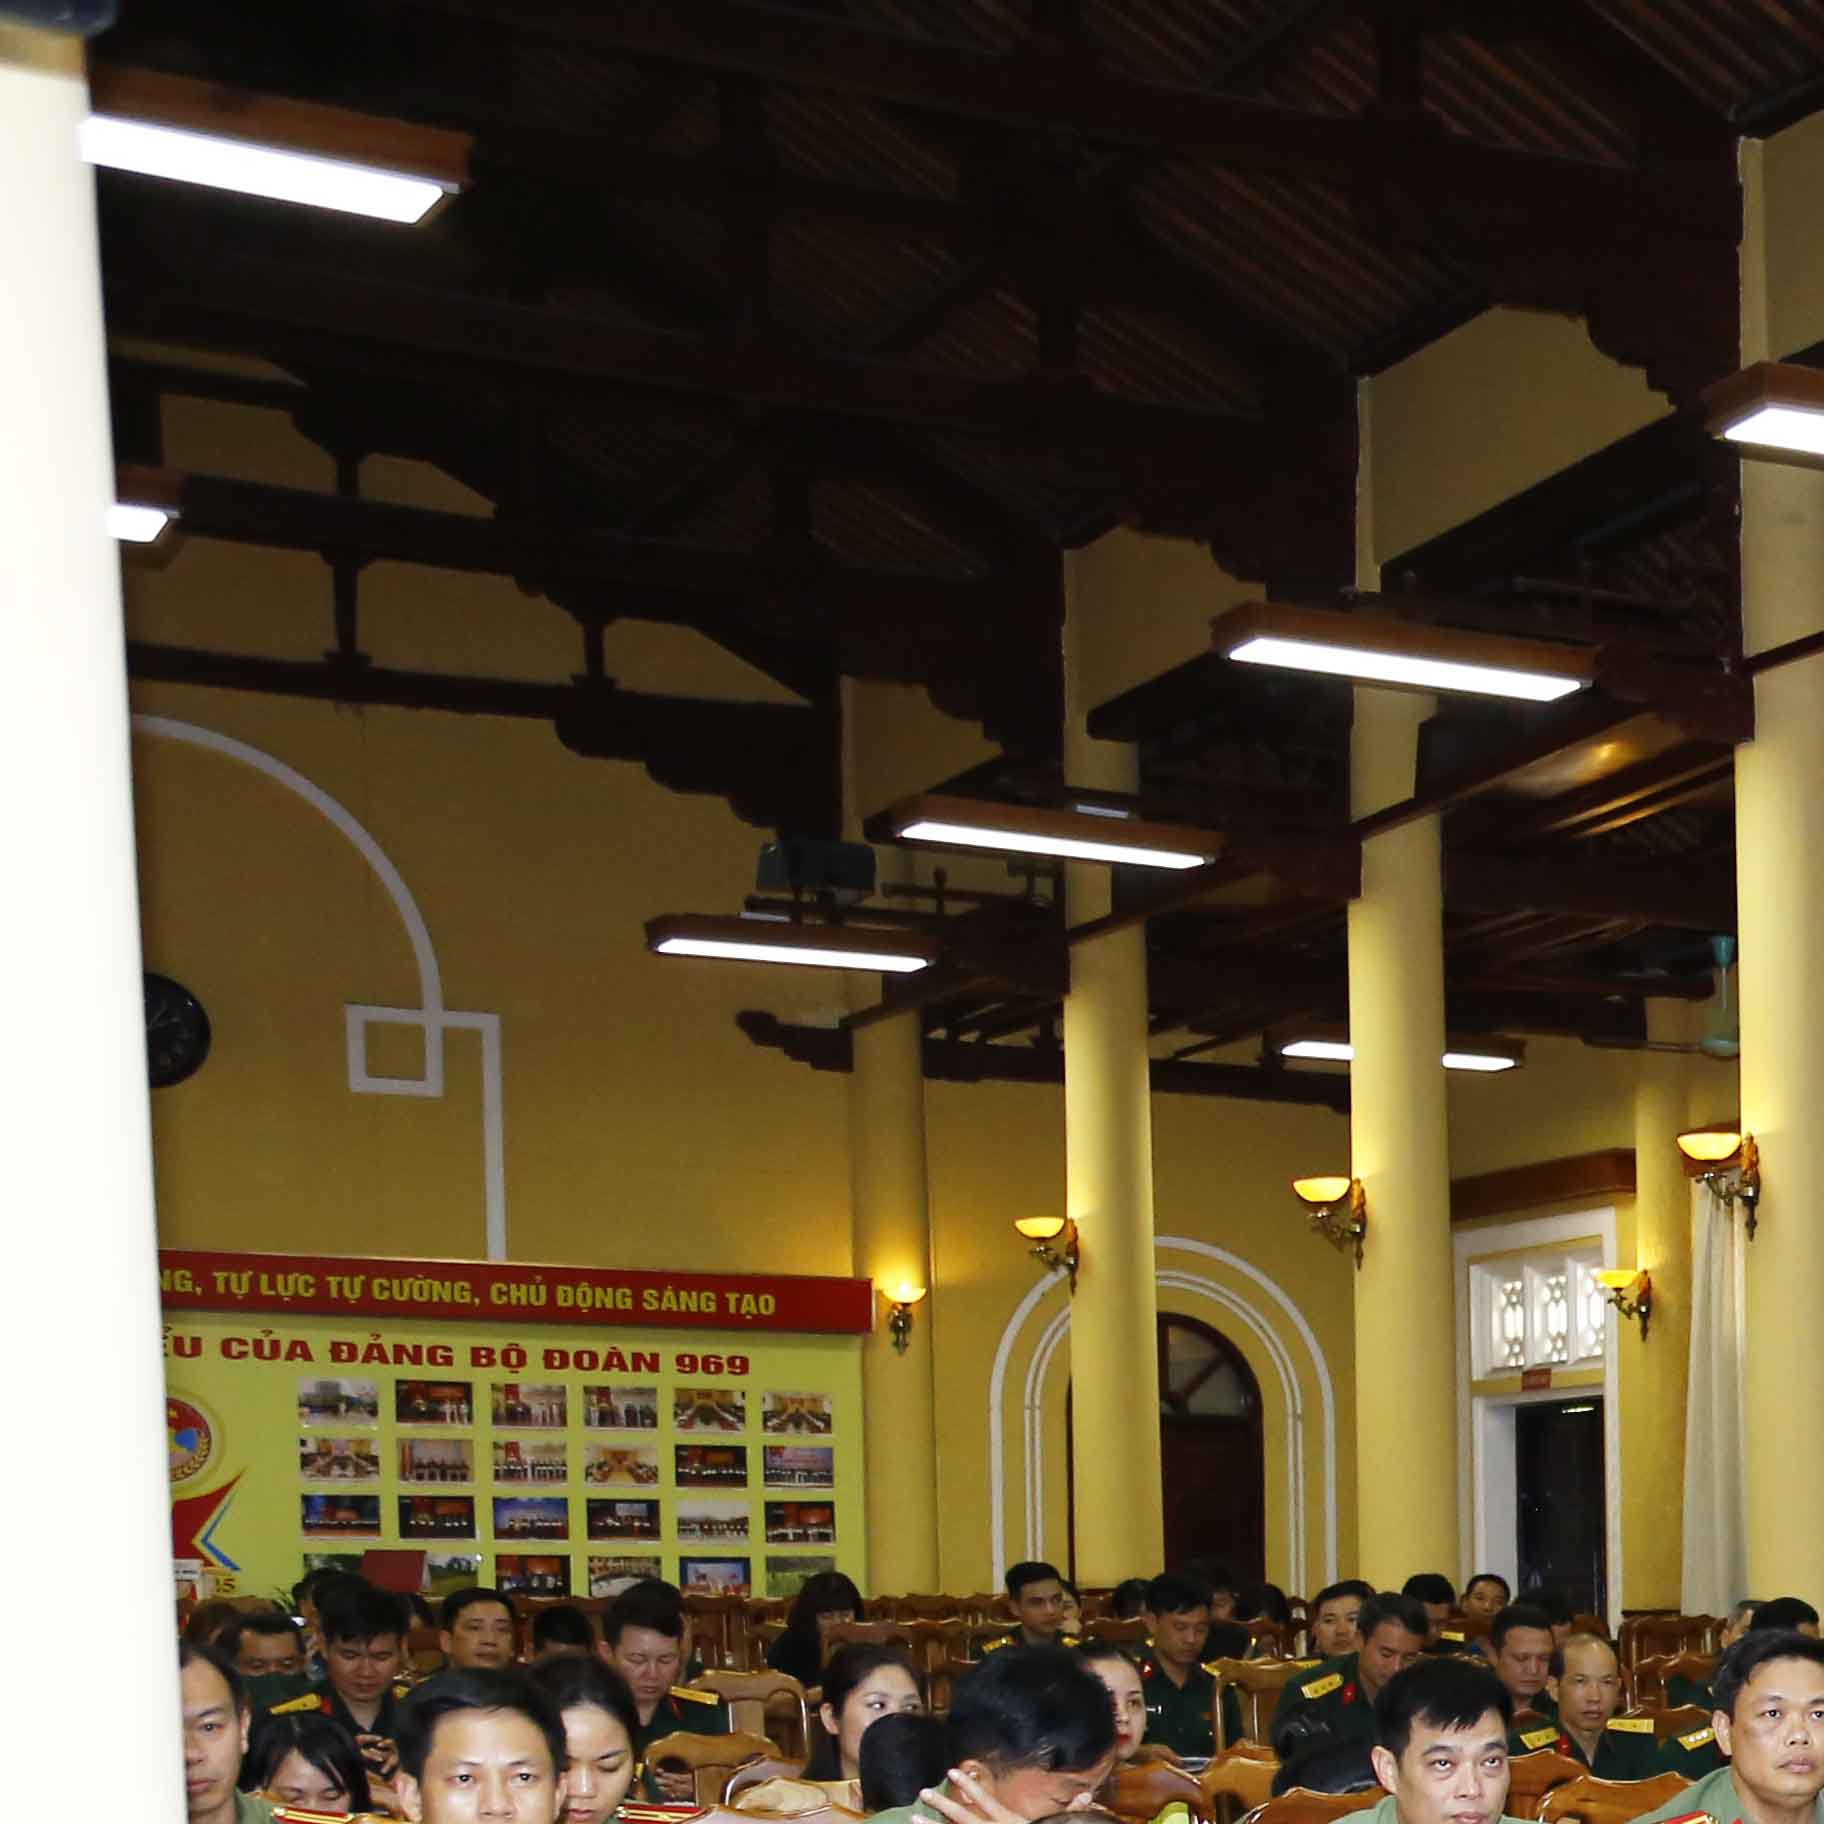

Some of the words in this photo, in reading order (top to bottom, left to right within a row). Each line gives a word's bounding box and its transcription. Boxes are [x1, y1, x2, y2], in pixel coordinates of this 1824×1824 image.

[259, 1270, 316, 1302] LỰC
[371, 1274, 482, 1306] CƯỜNG,
[490, 1275, 548, 1308] CHỦ
[556, 1281, 634, 1313] ĐỘNG
[642, 1285, 718, 1315] SÁNG
[725, 1292, 777, 1320] TẠO
[220, 1328, 315, 1364] CỦA
[329, 1332, 455, 1368] ĐẢNG
[469, 1342, 529, 1375] BỘ
[542, 1346, 662, 1375] ĐOÀN
[674, 1353, 751, 1377] 969
